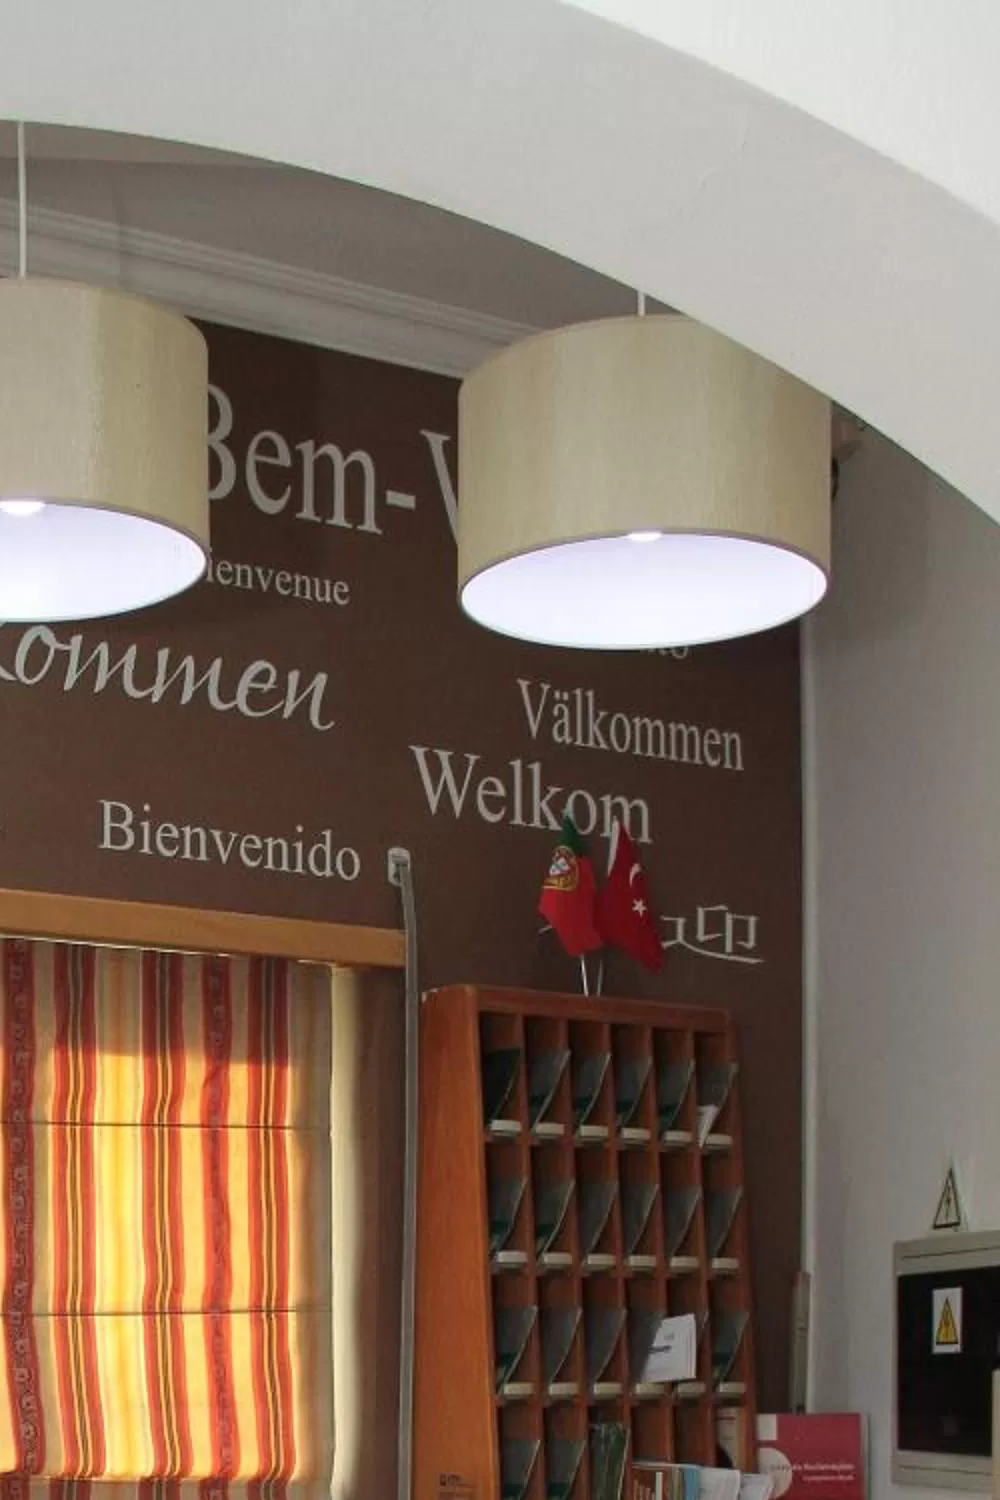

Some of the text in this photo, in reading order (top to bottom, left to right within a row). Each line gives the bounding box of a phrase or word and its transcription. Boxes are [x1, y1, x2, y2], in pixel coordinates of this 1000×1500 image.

[206, 546, 350, 605] ienvenue
[516, 677, 745, 771] Välkommen
[409, 744, 654, 844] Welkom
[98, 799, 361, 881] Bienvenido
